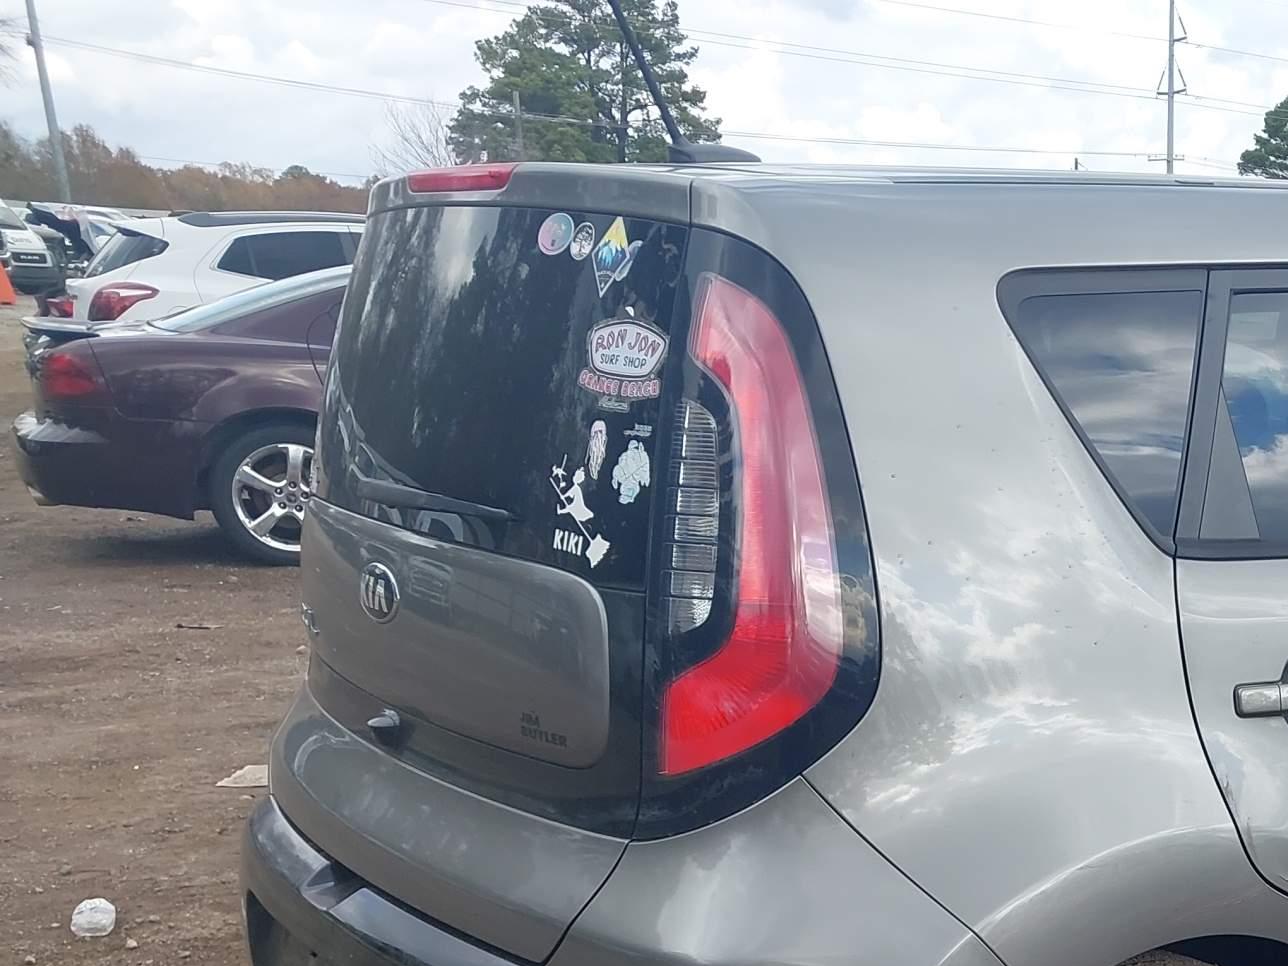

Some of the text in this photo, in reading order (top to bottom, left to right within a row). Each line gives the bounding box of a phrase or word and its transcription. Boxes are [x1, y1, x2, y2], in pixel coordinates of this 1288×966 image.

[594, 328, 662, 360] RON JON
[600, 353, 648, 369] SURF SHOP
[578, 369, 660, 397] ORANGE BEACH
[553, 528, 584, 557] KIKI
